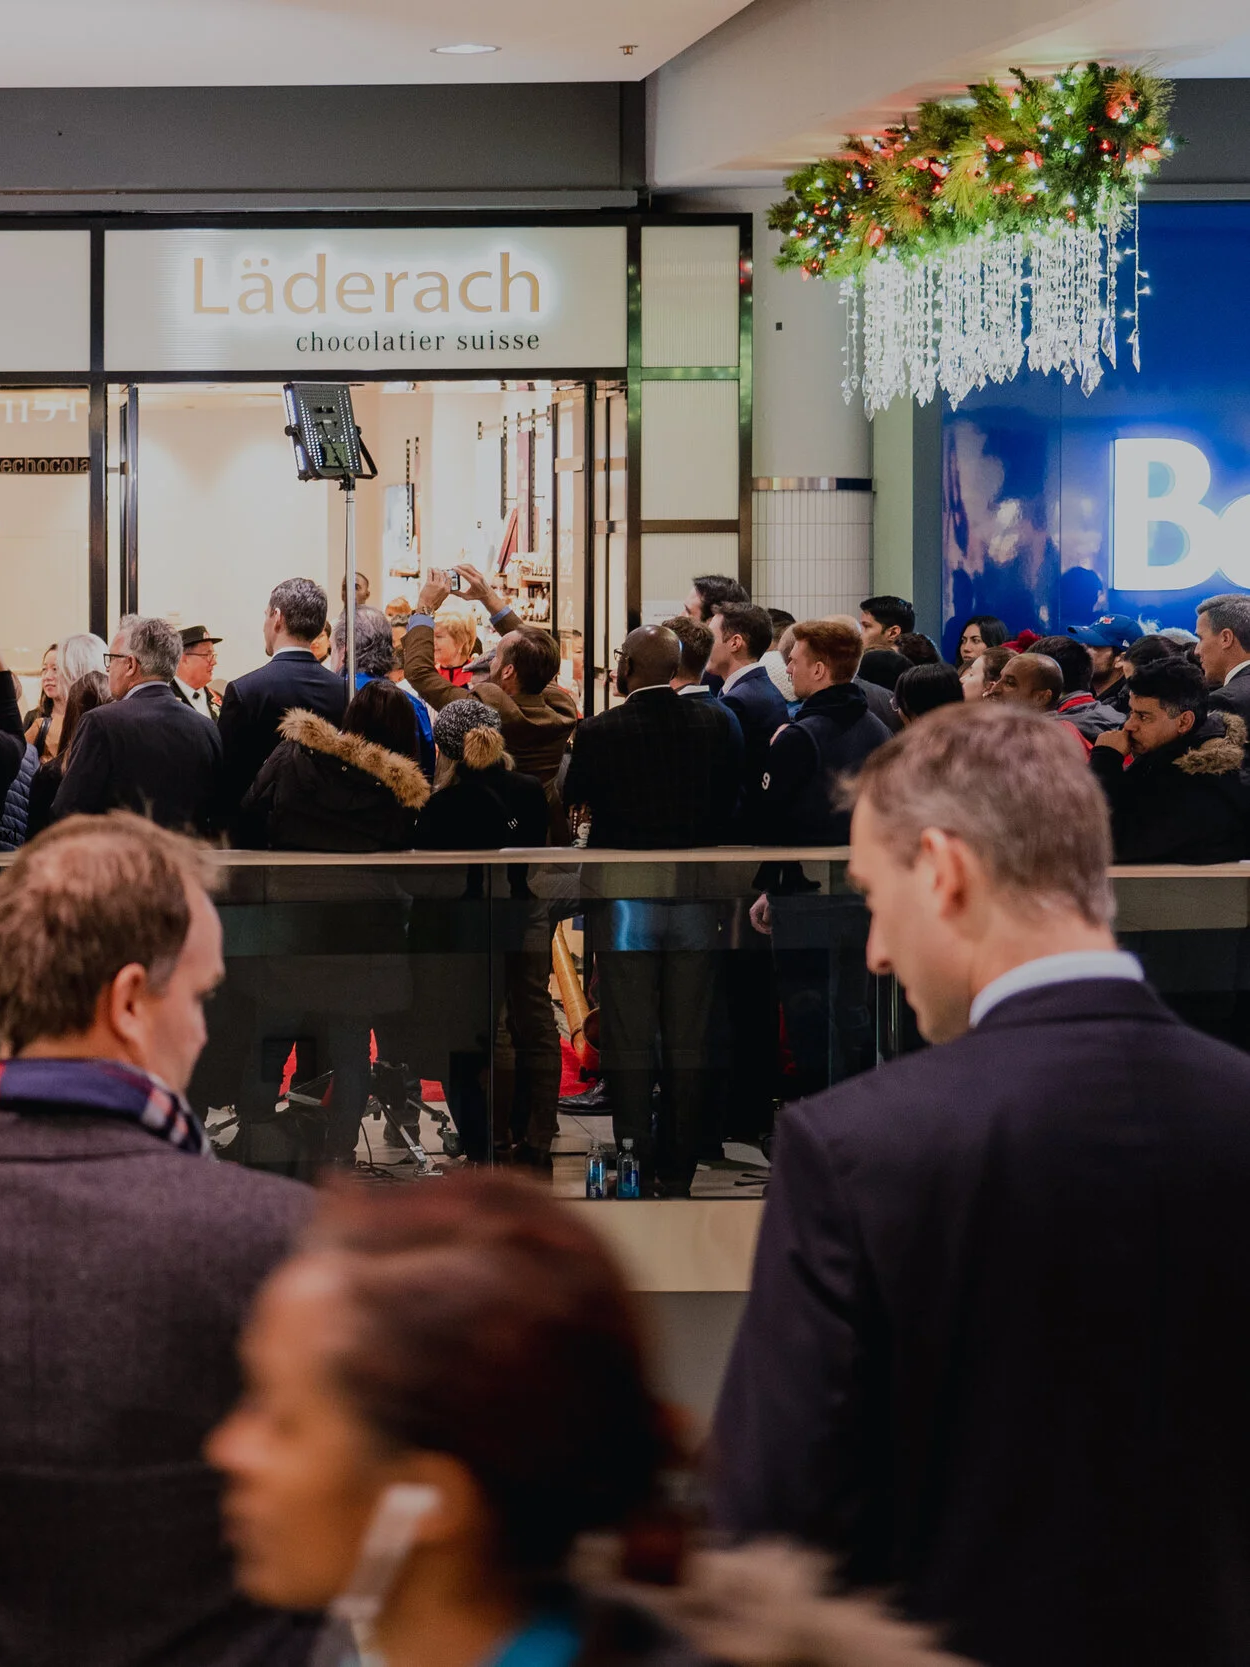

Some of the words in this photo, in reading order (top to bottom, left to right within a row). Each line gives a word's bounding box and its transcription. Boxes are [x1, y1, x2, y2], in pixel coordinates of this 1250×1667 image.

[194, 252, 540, 314] Läderach
[296, 331, 445, 351] chocolatier
[456, 330, 540, 351] suisse
